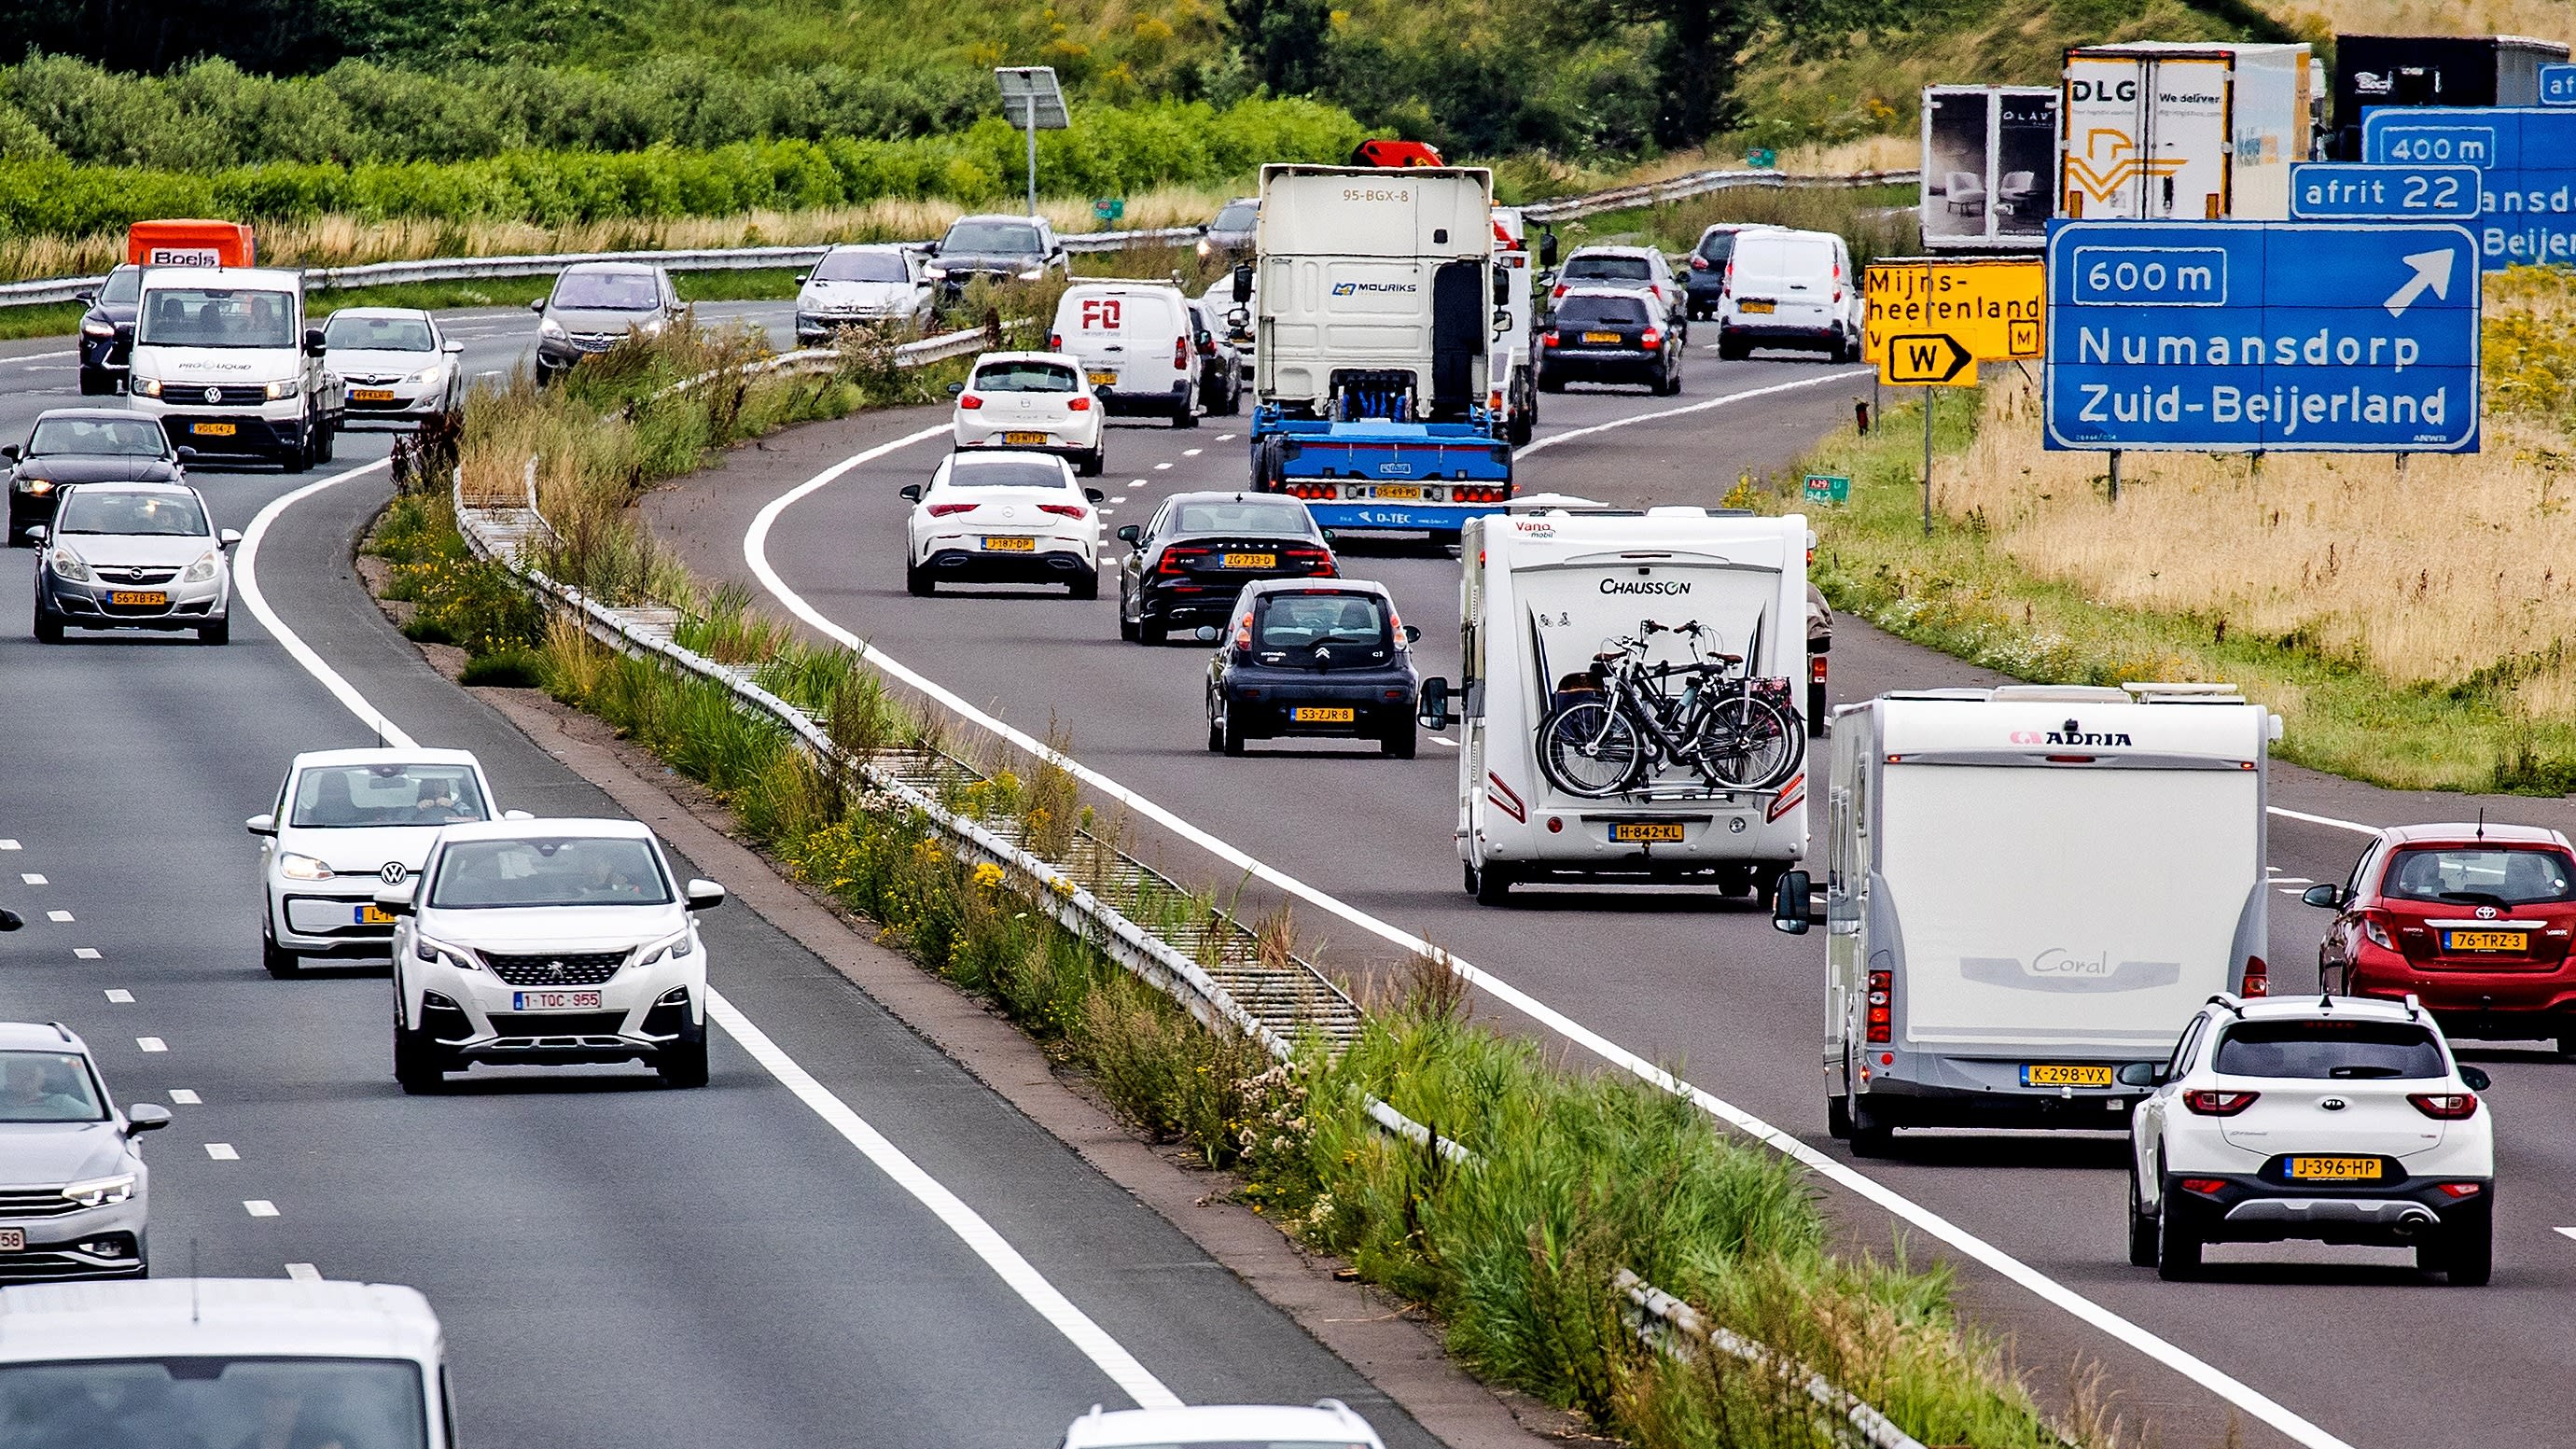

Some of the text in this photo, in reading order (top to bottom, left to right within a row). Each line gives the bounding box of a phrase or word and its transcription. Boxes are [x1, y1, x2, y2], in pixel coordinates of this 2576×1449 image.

[2072, 80, 2136, 102] DLG
[2160, 93, 2177, 103] We
[2391, 139, 2484, 160] 400 m
[1344, 189, 1409, 202] 95-BGX-8
[2305, 176, 2458, 208] afrit 22
[2483, 186, 2576, 213] ansd
[2089, 262, 2212, 291] 600 m
[1358, 284, 1416, 292] MOURIKS
[1869, 270, 1968, 300] Mijns-
[1869, 296, 2040, 321] heerenland
[2017, 330, 2030, 345] M
[2079, 327, 2419, 373] Numansdorp
[1910, 345, 1937, 372] W
[2079, 383, 2445, 436] Zuid-Beijerland
[1376, 513, 1412, 523] D-TEC
[1515, 522, 1552, 532] Vano
[1531, 531, 1554, 539] mobil
[1228, 555, 1271, 564] ZG-733-D
[1599, 578, 1692, 596] CHAUSSON
[117, 593, 162, 603] 56-XB-FX
[1302, 709, 1349, 719] 53-ZJR-8
[2046, 731, 2132, 746] ADRIA
[1620, 827, 1678, 838] H-842-KL
[2458, 934, 2520, 947] 76-TRZ-3
[2032, 948, 2107, 973] Coral
[2034, 1068, 2106, 1081] K-298-VX
[2299, 1160, 2374, 1175] J-396-HP
